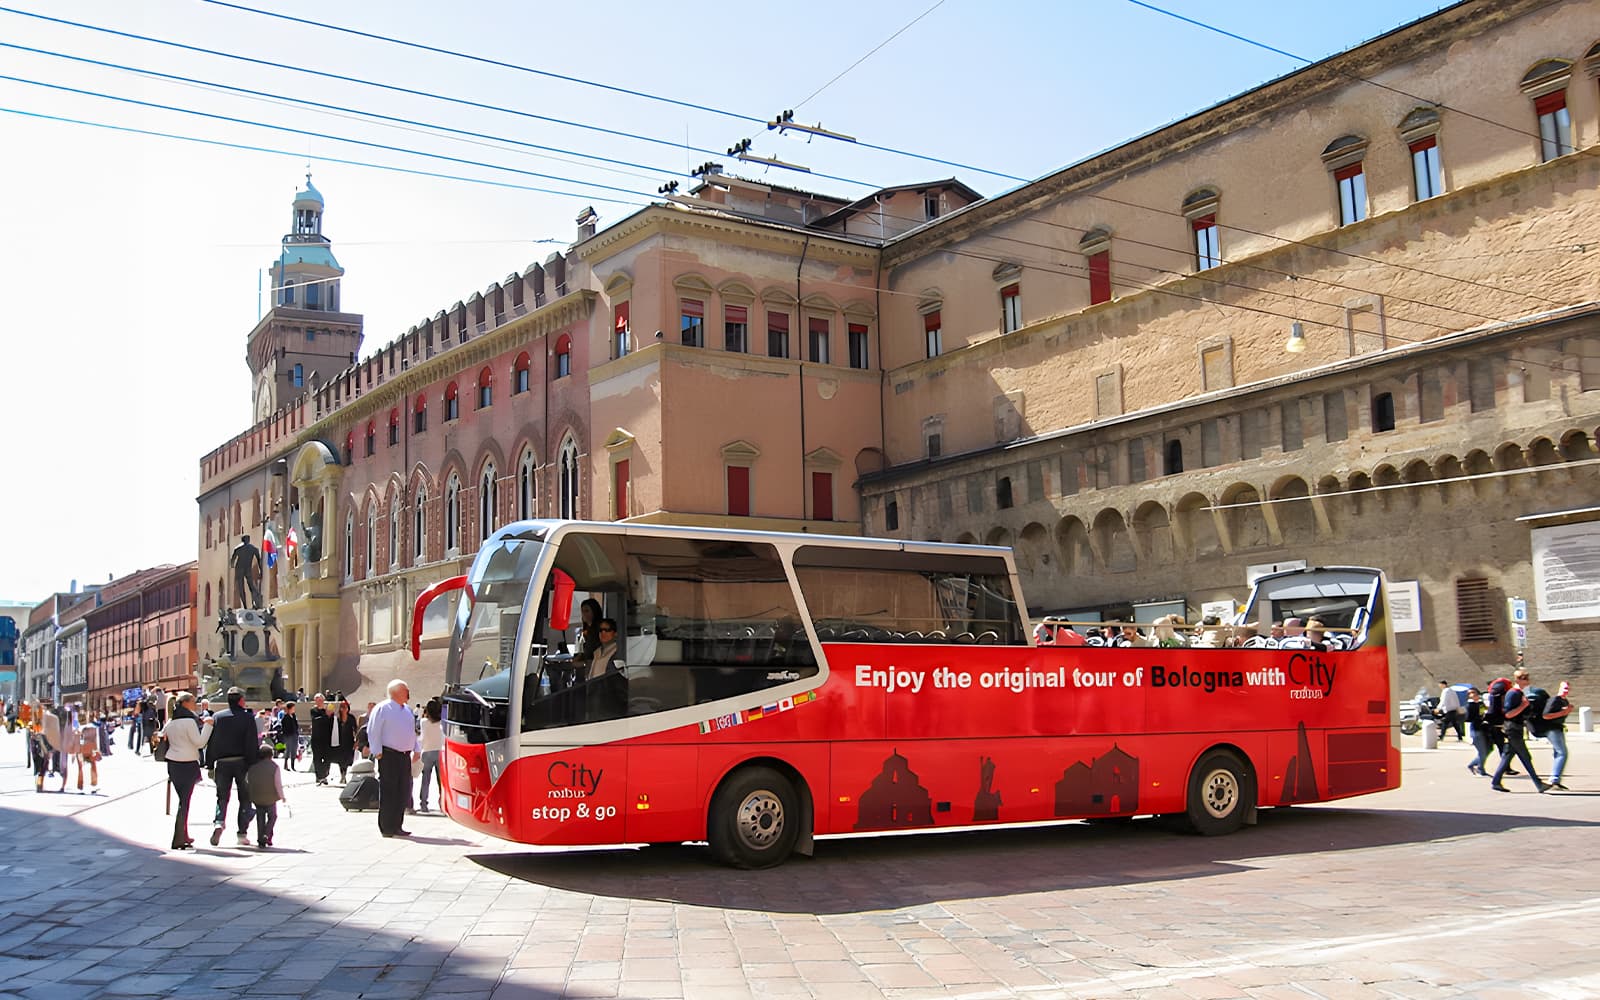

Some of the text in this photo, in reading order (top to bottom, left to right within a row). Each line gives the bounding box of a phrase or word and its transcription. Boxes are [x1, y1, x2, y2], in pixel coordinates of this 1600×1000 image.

[855, 653, 1337, 697] Enjoy the original tour of Bologna with City
[548, 761, 603, 796] City
[532, 803, 616, 822] stop & go
